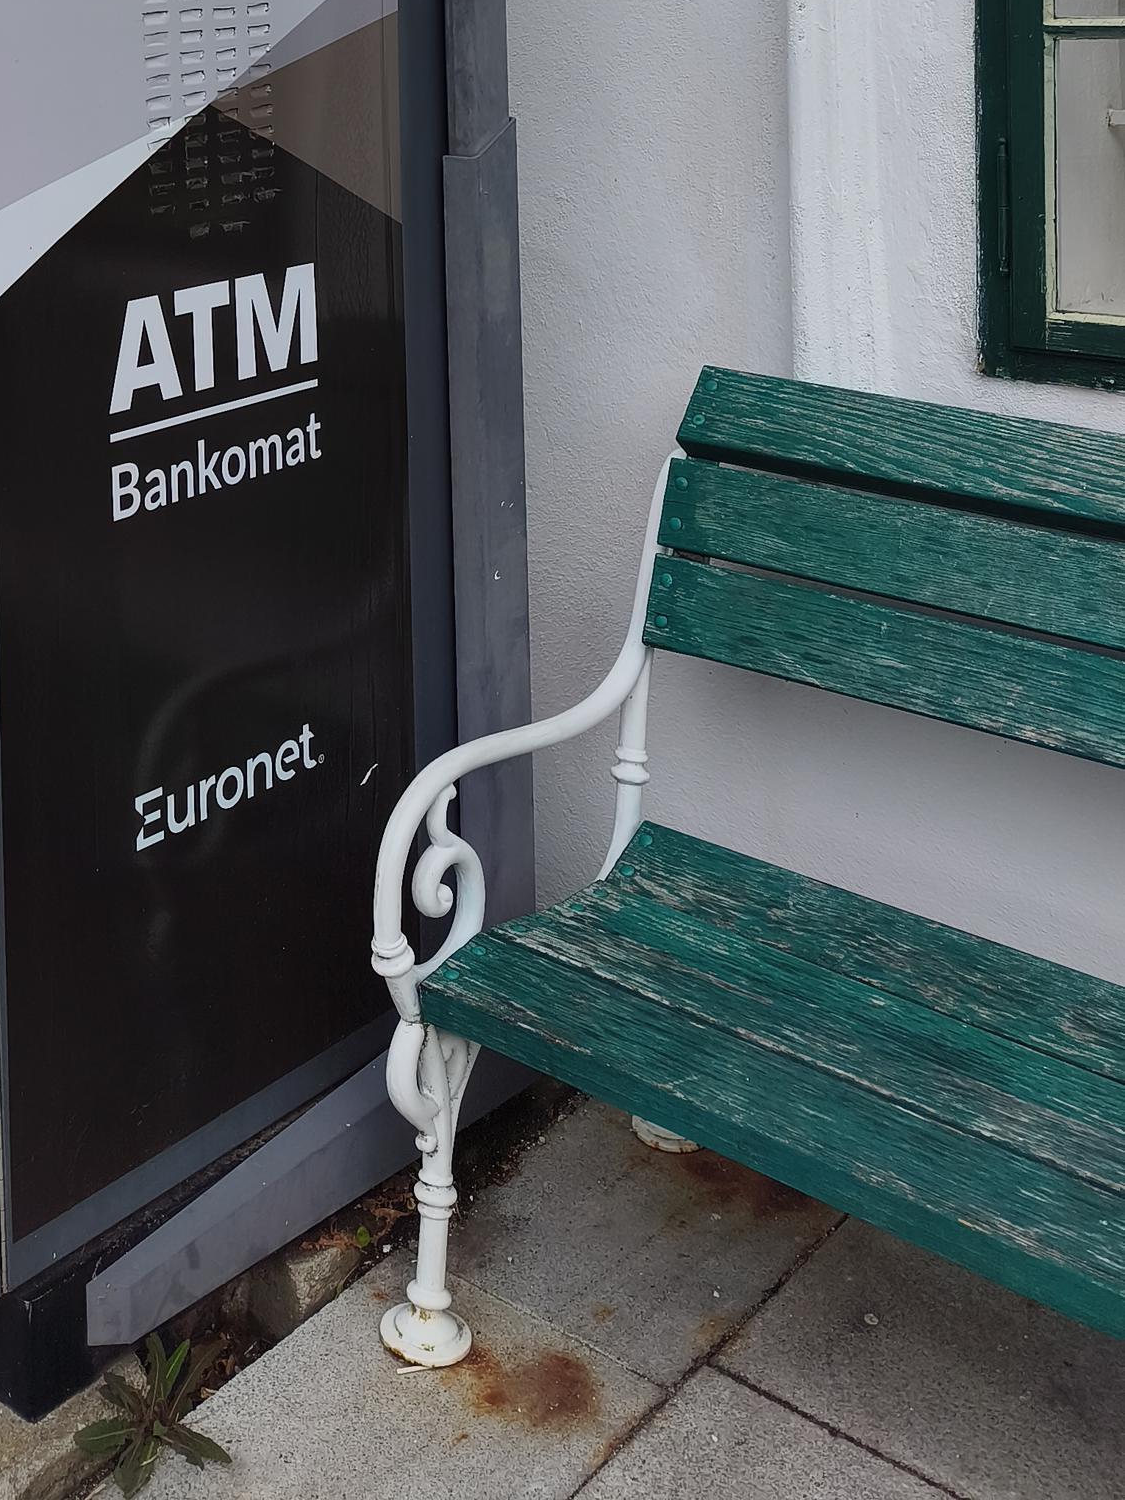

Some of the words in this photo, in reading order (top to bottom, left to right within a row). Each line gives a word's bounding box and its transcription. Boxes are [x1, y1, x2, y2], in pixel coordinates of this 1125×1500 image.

[109, 262, 318, 415] ATM
[111, 412, 322, 522] Bankomat
[135, 723, 317, 852] Euronet
